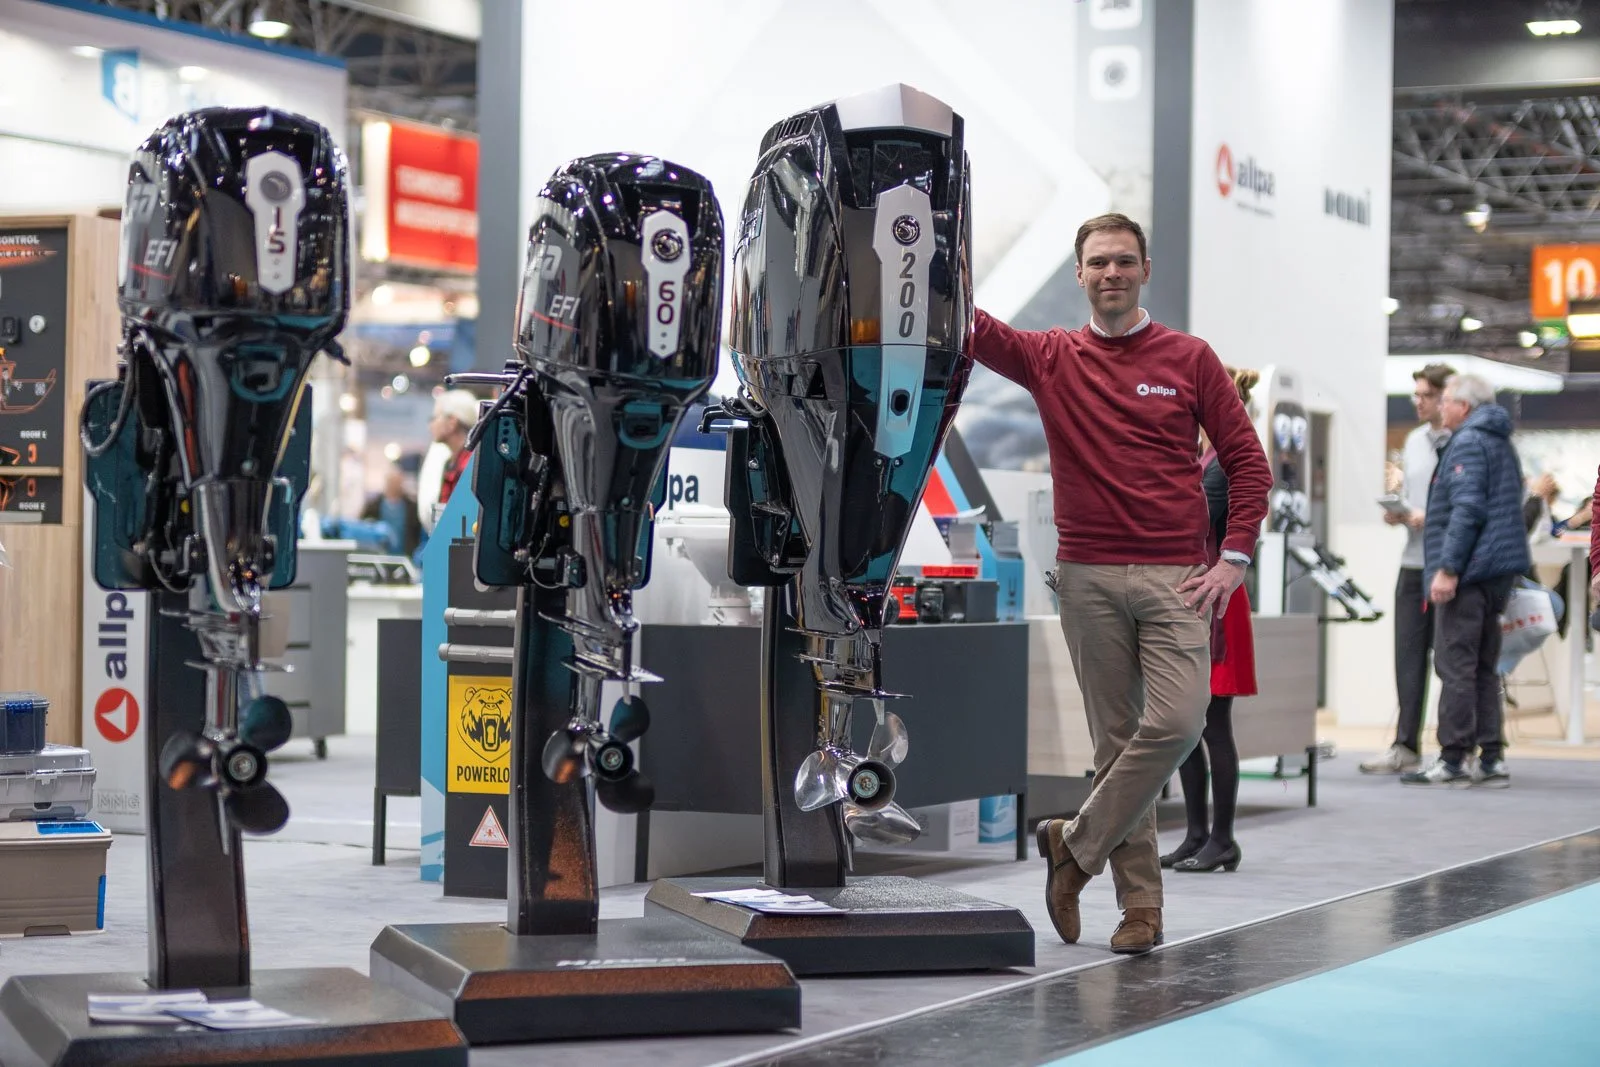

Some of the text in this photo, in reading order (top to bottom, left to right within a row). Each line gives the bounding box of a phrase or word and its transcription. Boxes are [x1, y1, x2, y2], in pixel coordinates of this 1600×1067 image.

[143, 239, 179, 268] EFI
[899, 252, 916, 338] 200
[1544, 257, 1597, 306] 10
[549, 294, 581, 320] EFI
[657, 281, 675, 325] 60
[1150, 386, 1177, 396] allpa
[669, 474, 699, 510] pa
[98, 592, 134, 680] allp
[456, 765, 510, 783] POWERLO
